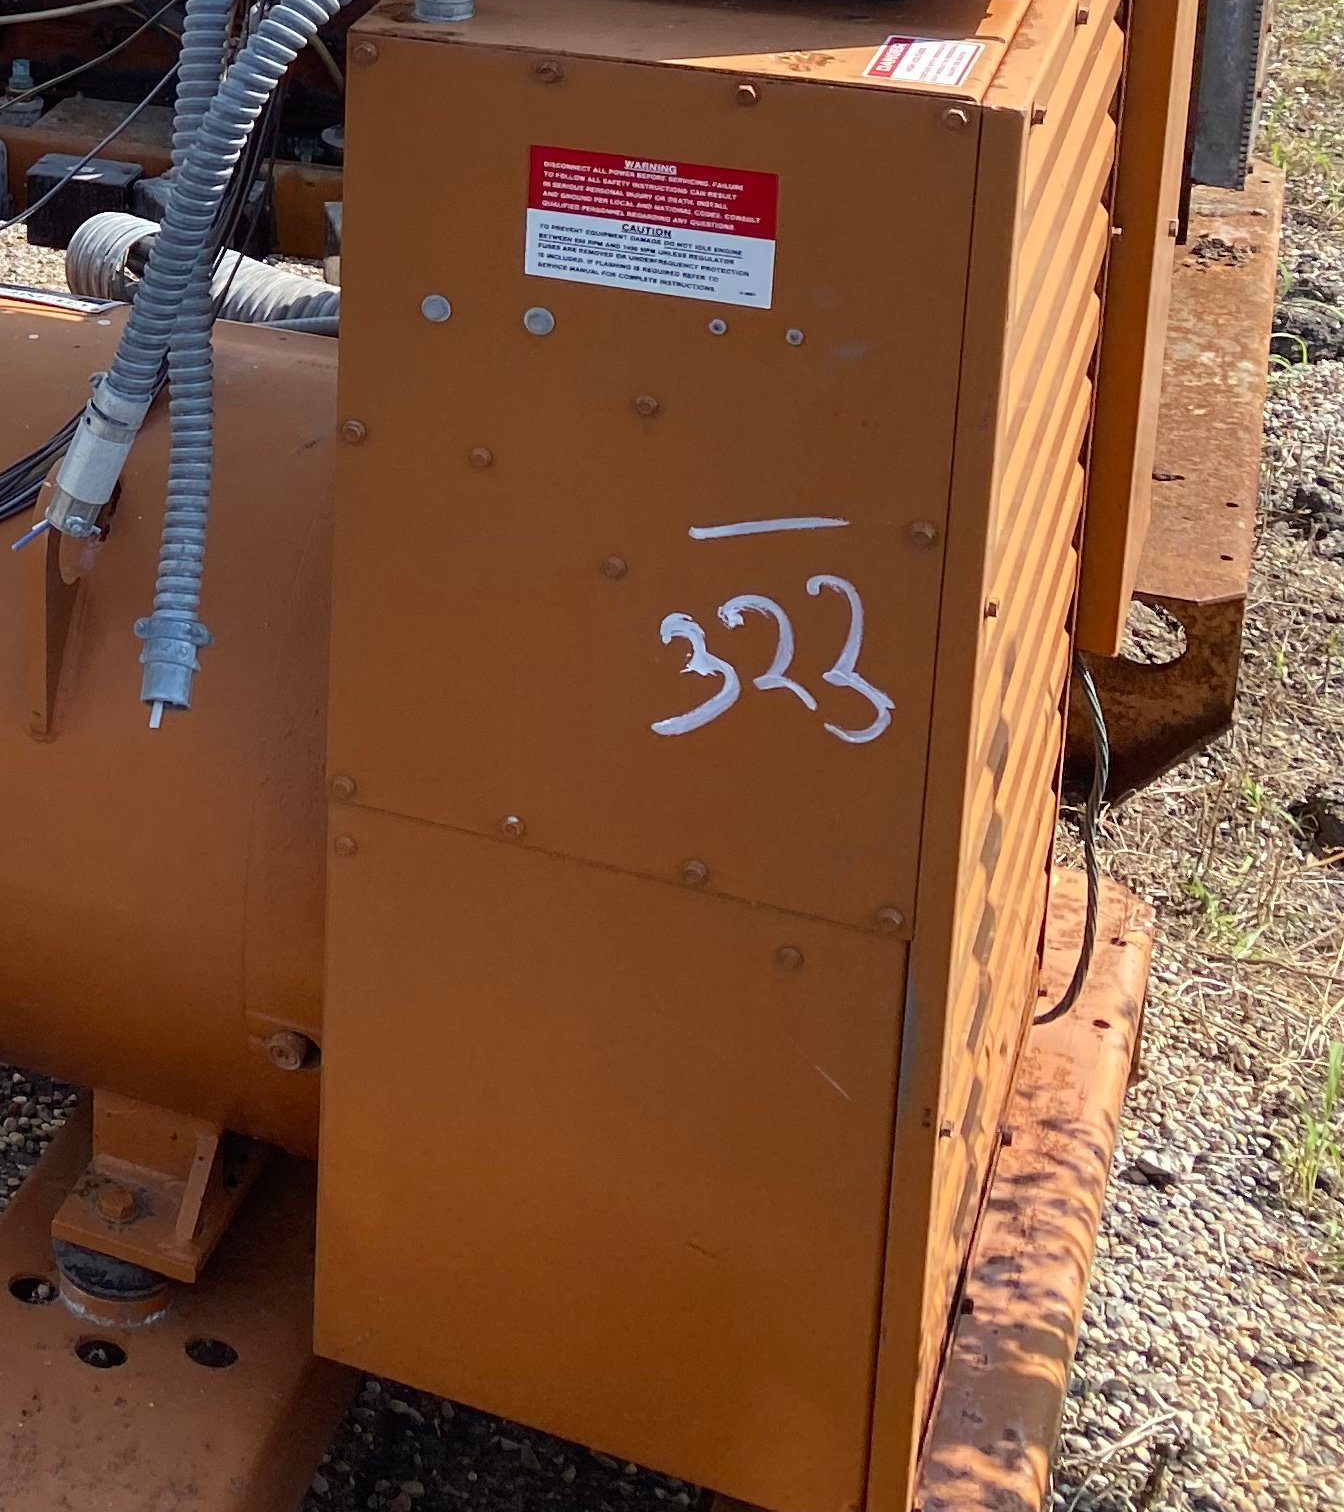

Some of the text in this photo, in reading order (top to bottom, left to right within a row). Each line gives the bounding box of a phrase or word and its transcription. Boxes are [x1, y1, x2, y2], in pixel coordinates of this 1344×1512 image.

[624, 159, 677, 175] WARNING
[622, 224, 672, 238] CAUTION
[651, 574, 896, 744] 323
